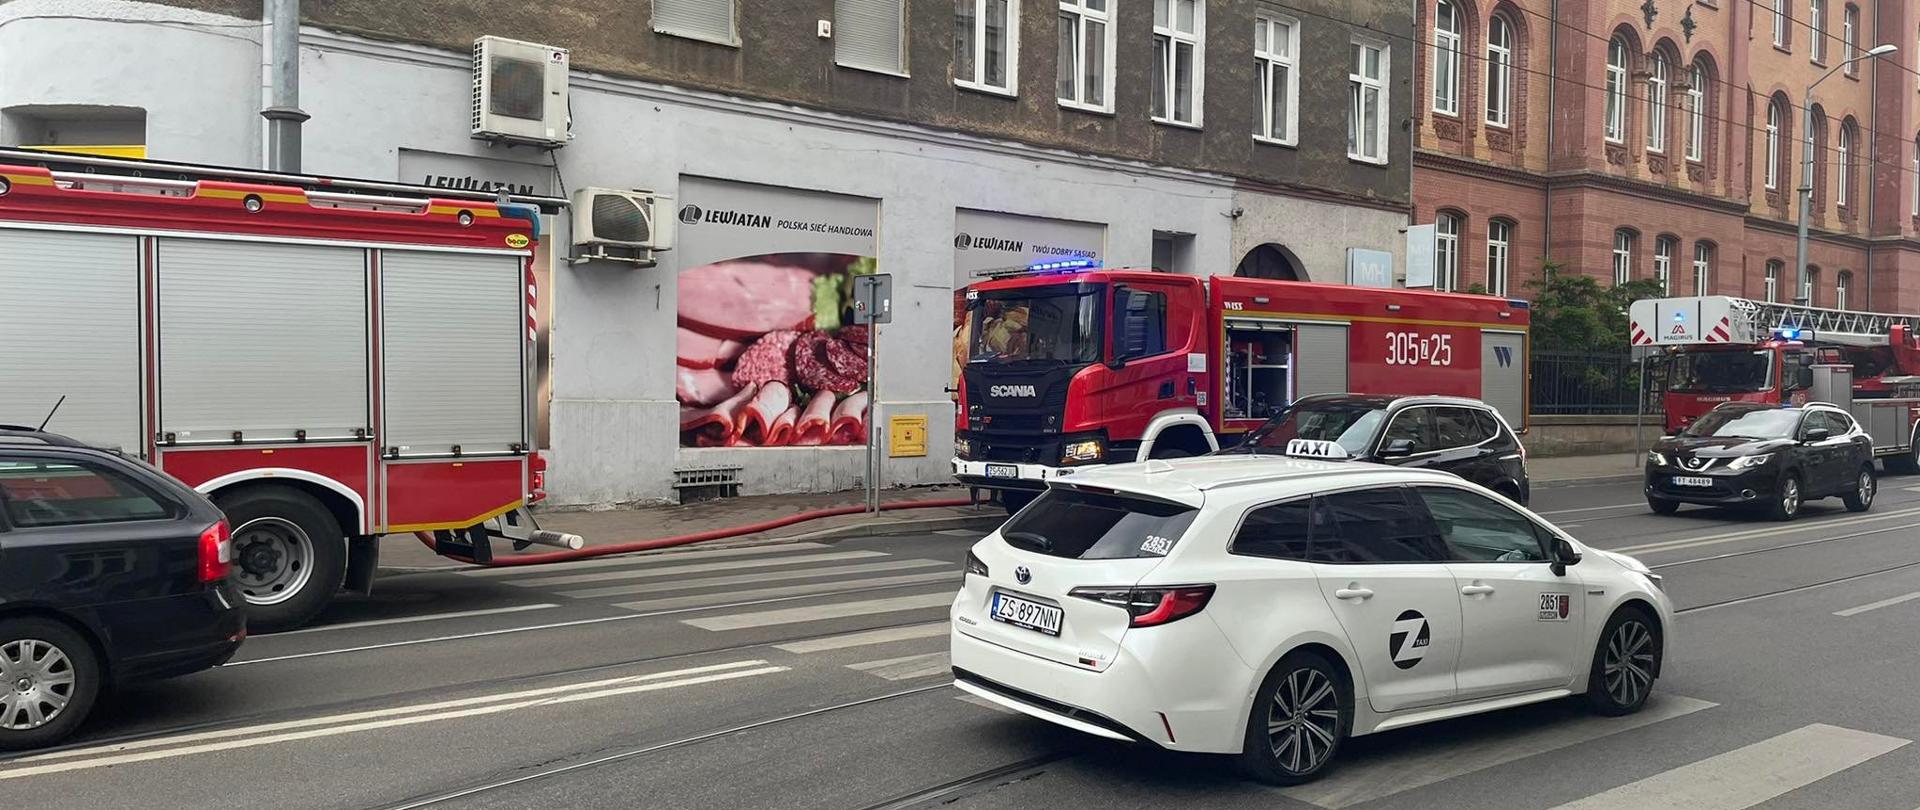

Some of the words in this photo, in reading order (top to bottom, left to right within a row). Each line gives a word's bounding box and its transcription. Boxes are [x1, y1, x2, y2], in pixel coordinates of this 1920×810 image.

[705, 209, 771, 229] LEWIATAN
[777, 219, 808, 231] POLSKA
[810, 222, 826, 233] SIEĆ
[828, 224, 873, 237] HANDLOWA
[973, 237, 1023, 252] LEWIATAN
[1032, 244, 1050, 254] TWÓJ
[1051, 247, 1073, 257] DOBRY
[990, 385, 1036, 398] SCANIA
[1290, 440, 1331, 456] TAXI
[1143, 535, 1173, 551] 2851
[1540, 594, 1558, 610] 2851
[999, 597, 1016, 618] ZS
[1018, 602, 1058, 630] 897NN
